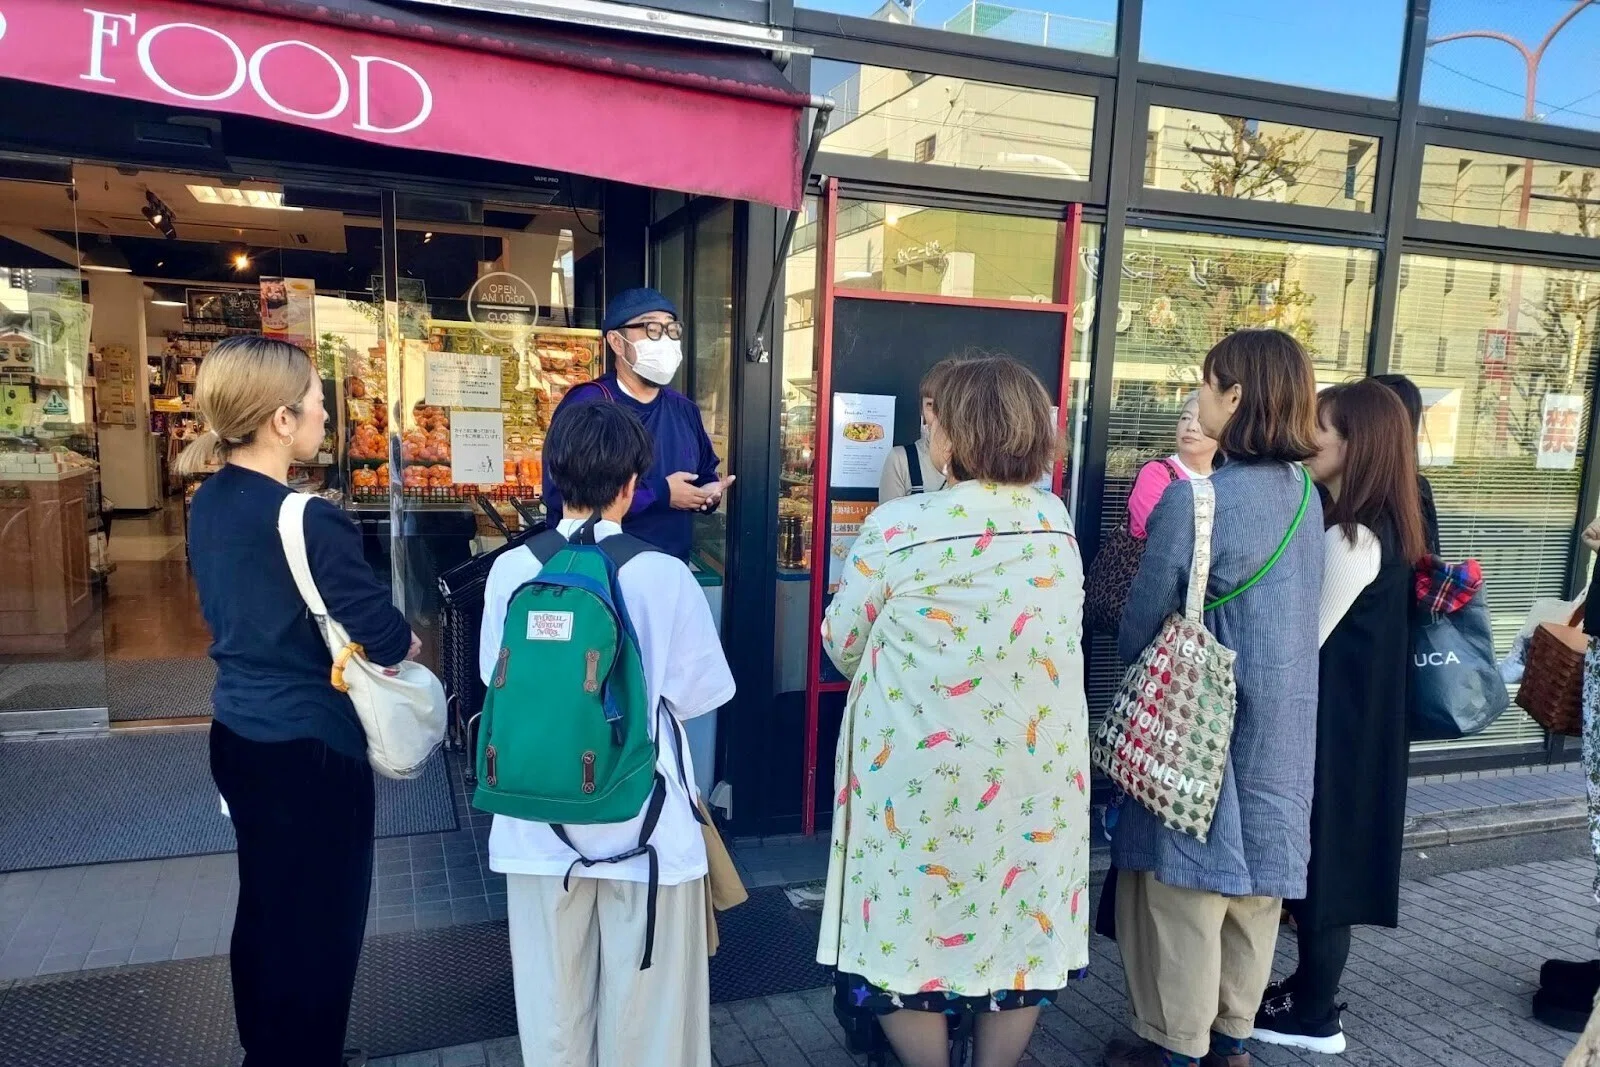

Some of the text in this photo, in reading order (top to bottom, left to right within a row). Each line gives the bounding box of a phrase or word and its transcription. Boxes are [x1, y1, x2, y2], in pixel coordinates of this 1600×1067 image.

[79, 8, 433, 134] FOOD
[489, 284, 517, 294] OPEN
[481, 293, 526, 304] AM 10:00
[1414, 651, 1461, 667] UCA
[1098, 722, 1210, 798] DEPARTMENT
